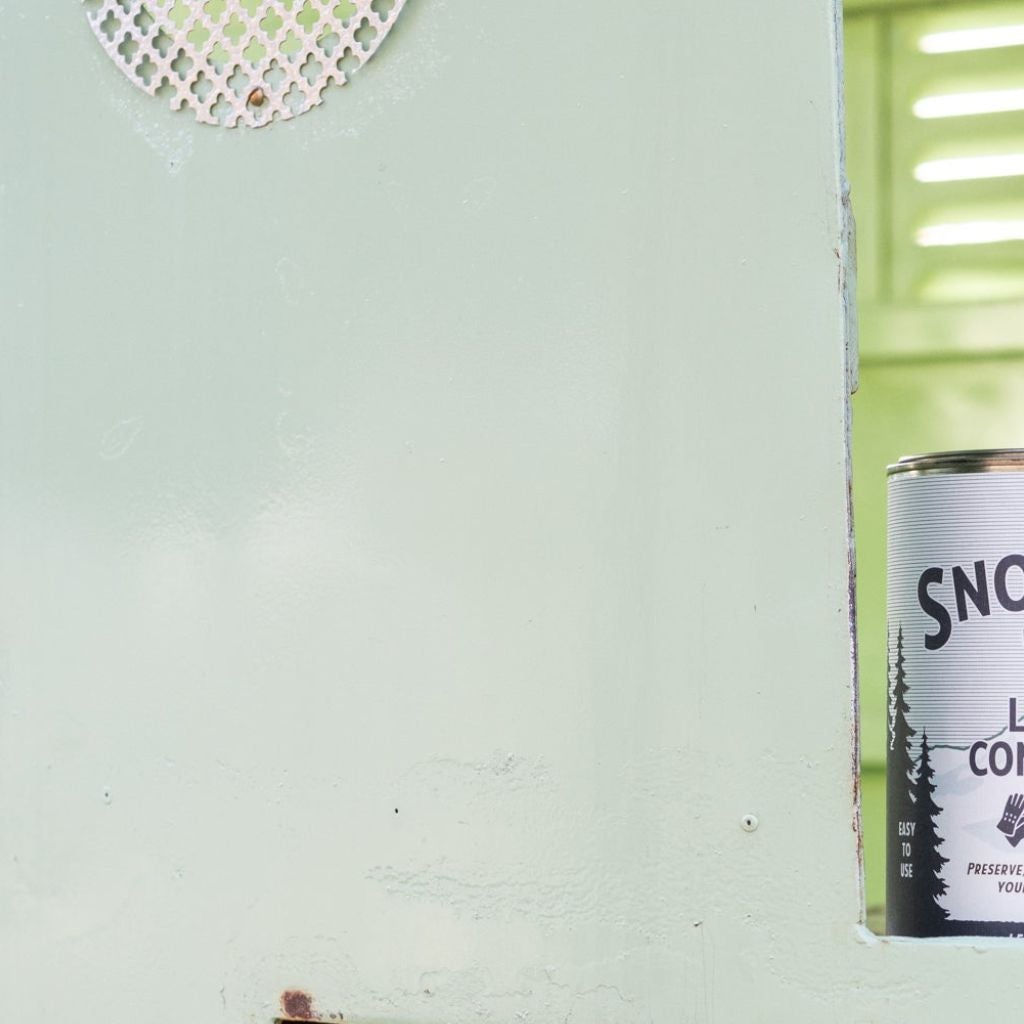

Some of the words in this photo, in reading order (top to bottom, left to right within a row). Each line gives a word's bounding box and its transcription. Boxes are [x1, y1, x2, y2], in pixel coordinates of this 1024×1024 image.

[898, 821, 916, 836] EASY
[902, 842, 911, 857] TO
[900, 863, 913, 878] USE
